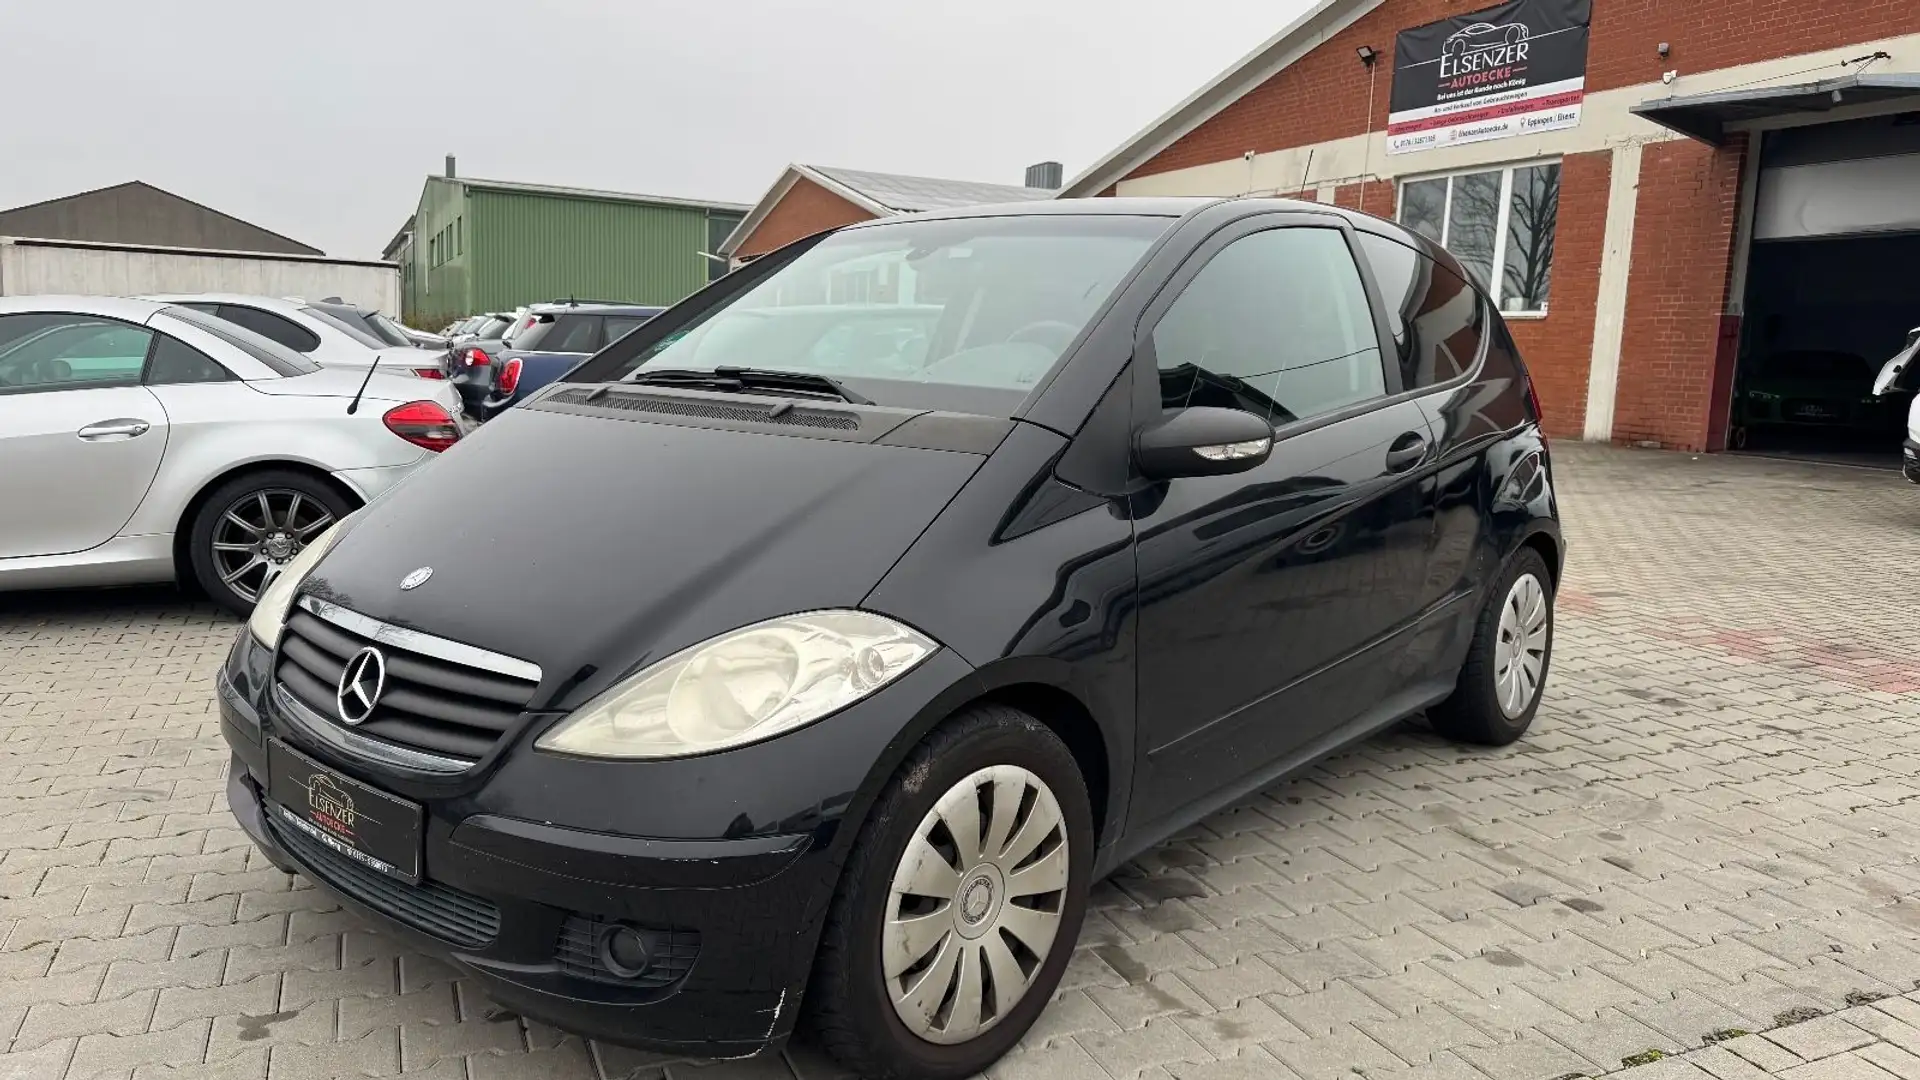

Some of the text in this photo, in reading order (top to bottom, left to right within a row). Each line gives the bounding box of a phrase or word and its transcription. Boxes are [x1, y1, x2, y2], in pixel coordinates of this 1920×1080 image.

[1440, 42, 1529, 78] ELSENZER
[1450, 66, 1512, 89] AUTOECKE
[1464, 88, 1474, 96] der
[1508, 78, 1527, 88] König
[309, 787, 355, 828] ELSENZER
